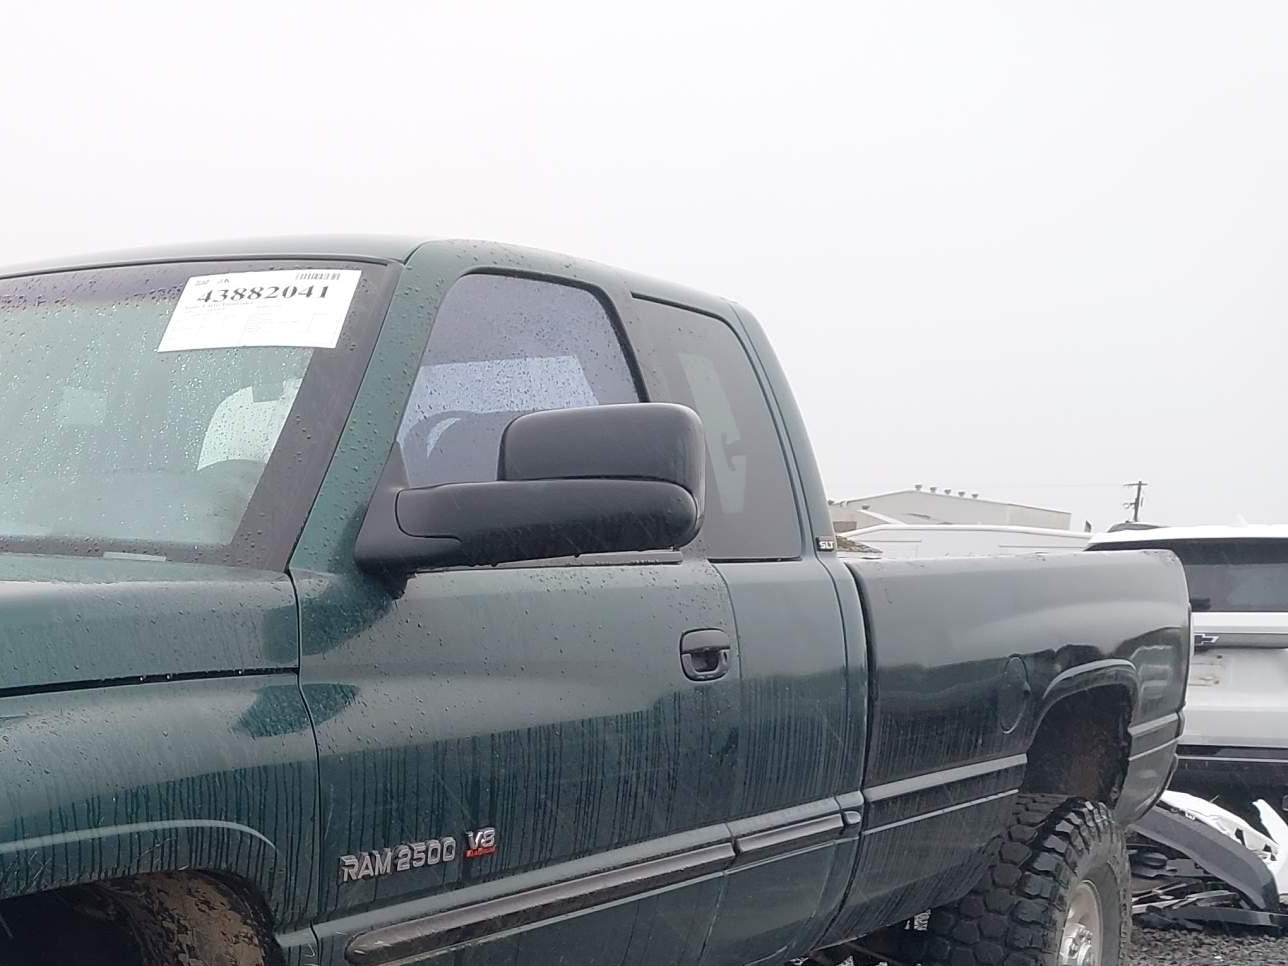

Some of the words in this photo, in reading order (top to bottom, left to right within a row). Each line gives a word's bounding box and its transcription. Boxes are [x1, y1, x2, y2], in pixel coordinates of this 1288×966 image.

[197, 284, 329, 303] 43882041
[819, 540, 835, 550] SLT
[339, 847, 393, 883] RAM
[395, 836, 457, 872] 2500
[465, 827, 496, 850] V8
